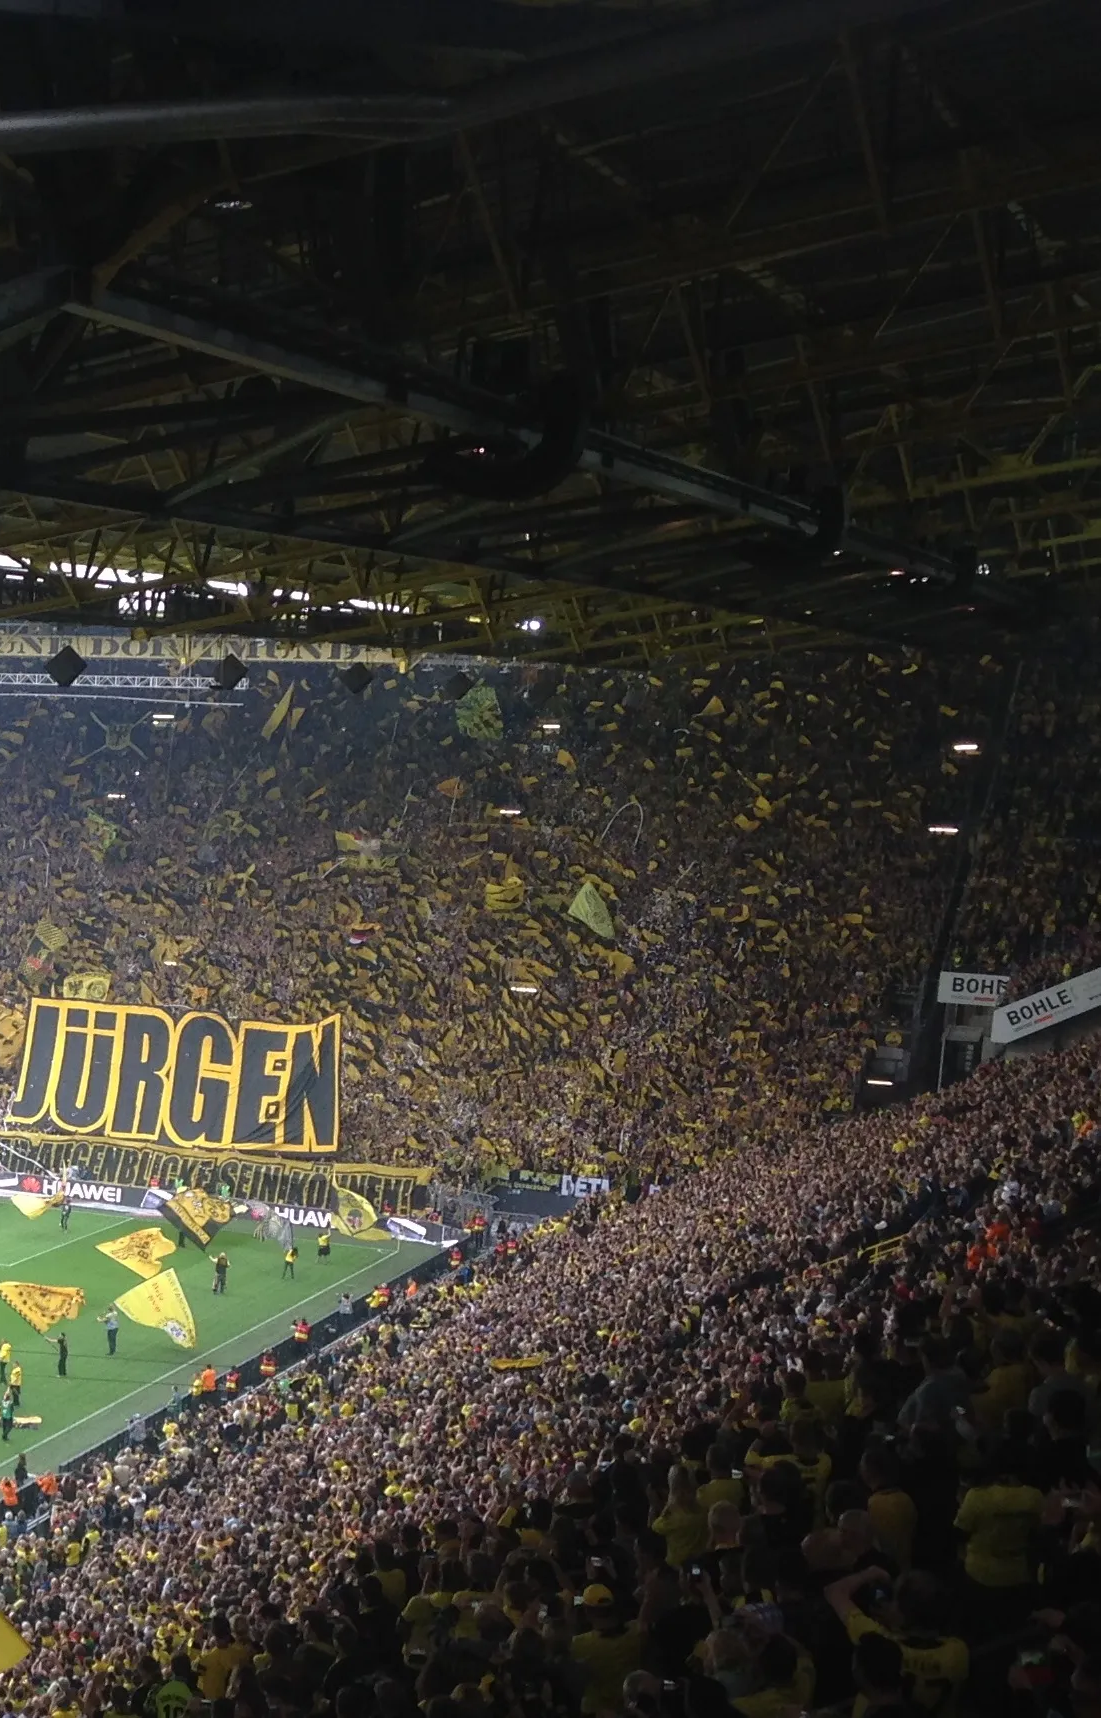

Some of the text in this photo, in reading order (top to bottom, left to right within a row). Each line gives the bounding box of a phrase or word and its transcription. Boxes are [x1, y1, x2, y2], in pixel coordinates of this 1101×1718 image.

[1006, 989, 1072, 1026] BOHLE
[5, 997, 341, 1151] JÜRGEN
[42, 1179, 122, 1203] HUAWEI
[218, 1157, 286, 1203] SEIN
[274, 1205, 336, 1229] HUAW
